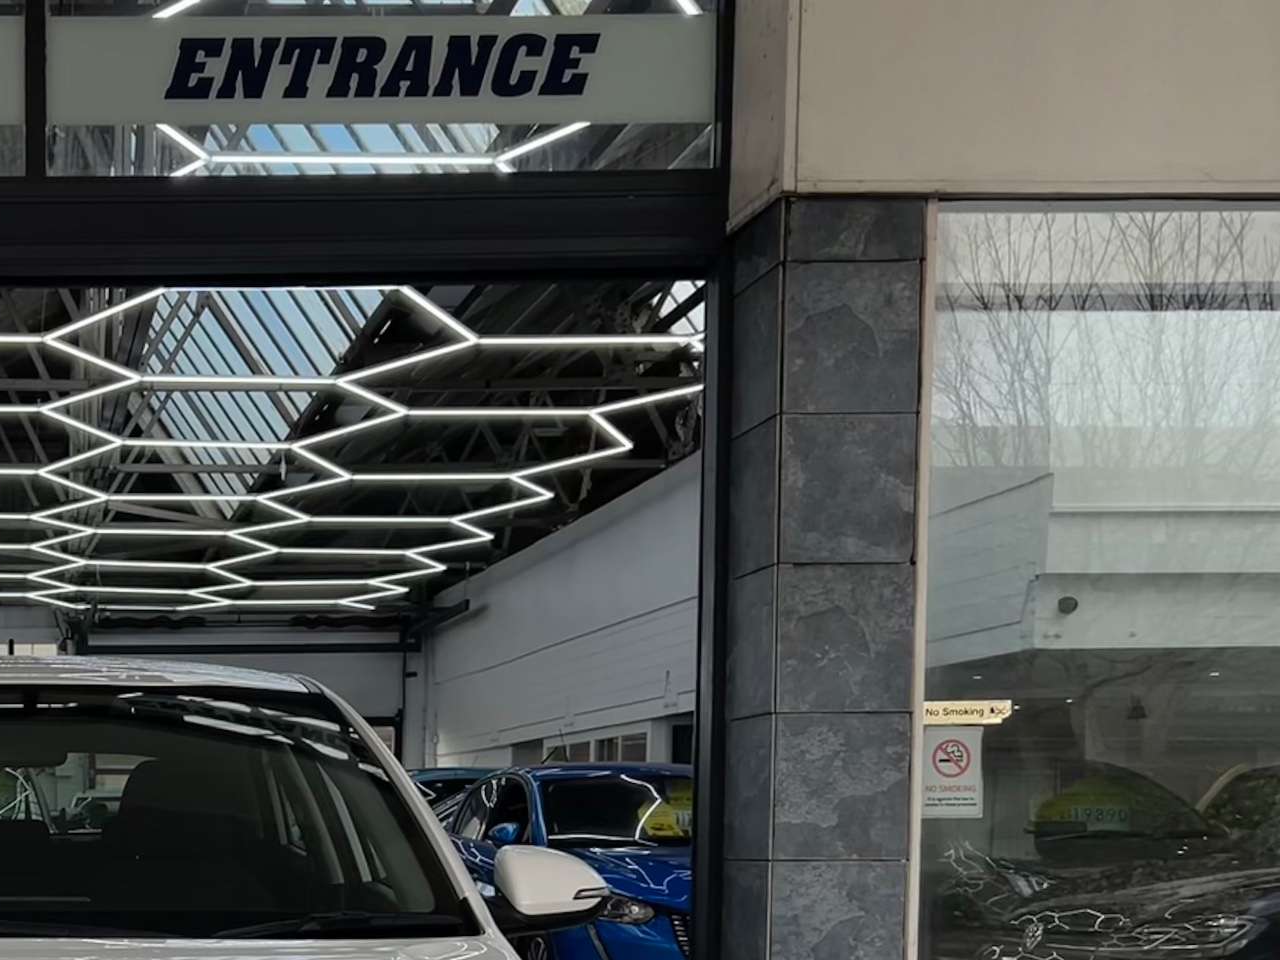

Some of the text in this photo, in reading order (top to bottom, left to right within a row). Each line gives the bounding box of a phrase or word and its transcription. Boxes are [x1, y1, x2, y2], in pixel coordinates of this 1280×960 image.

[164, 33, 601, 100] ENTRANCE
[925, 706, 984, 718] No Smoking
[925, 784, 977, 794] NO SMOKING
